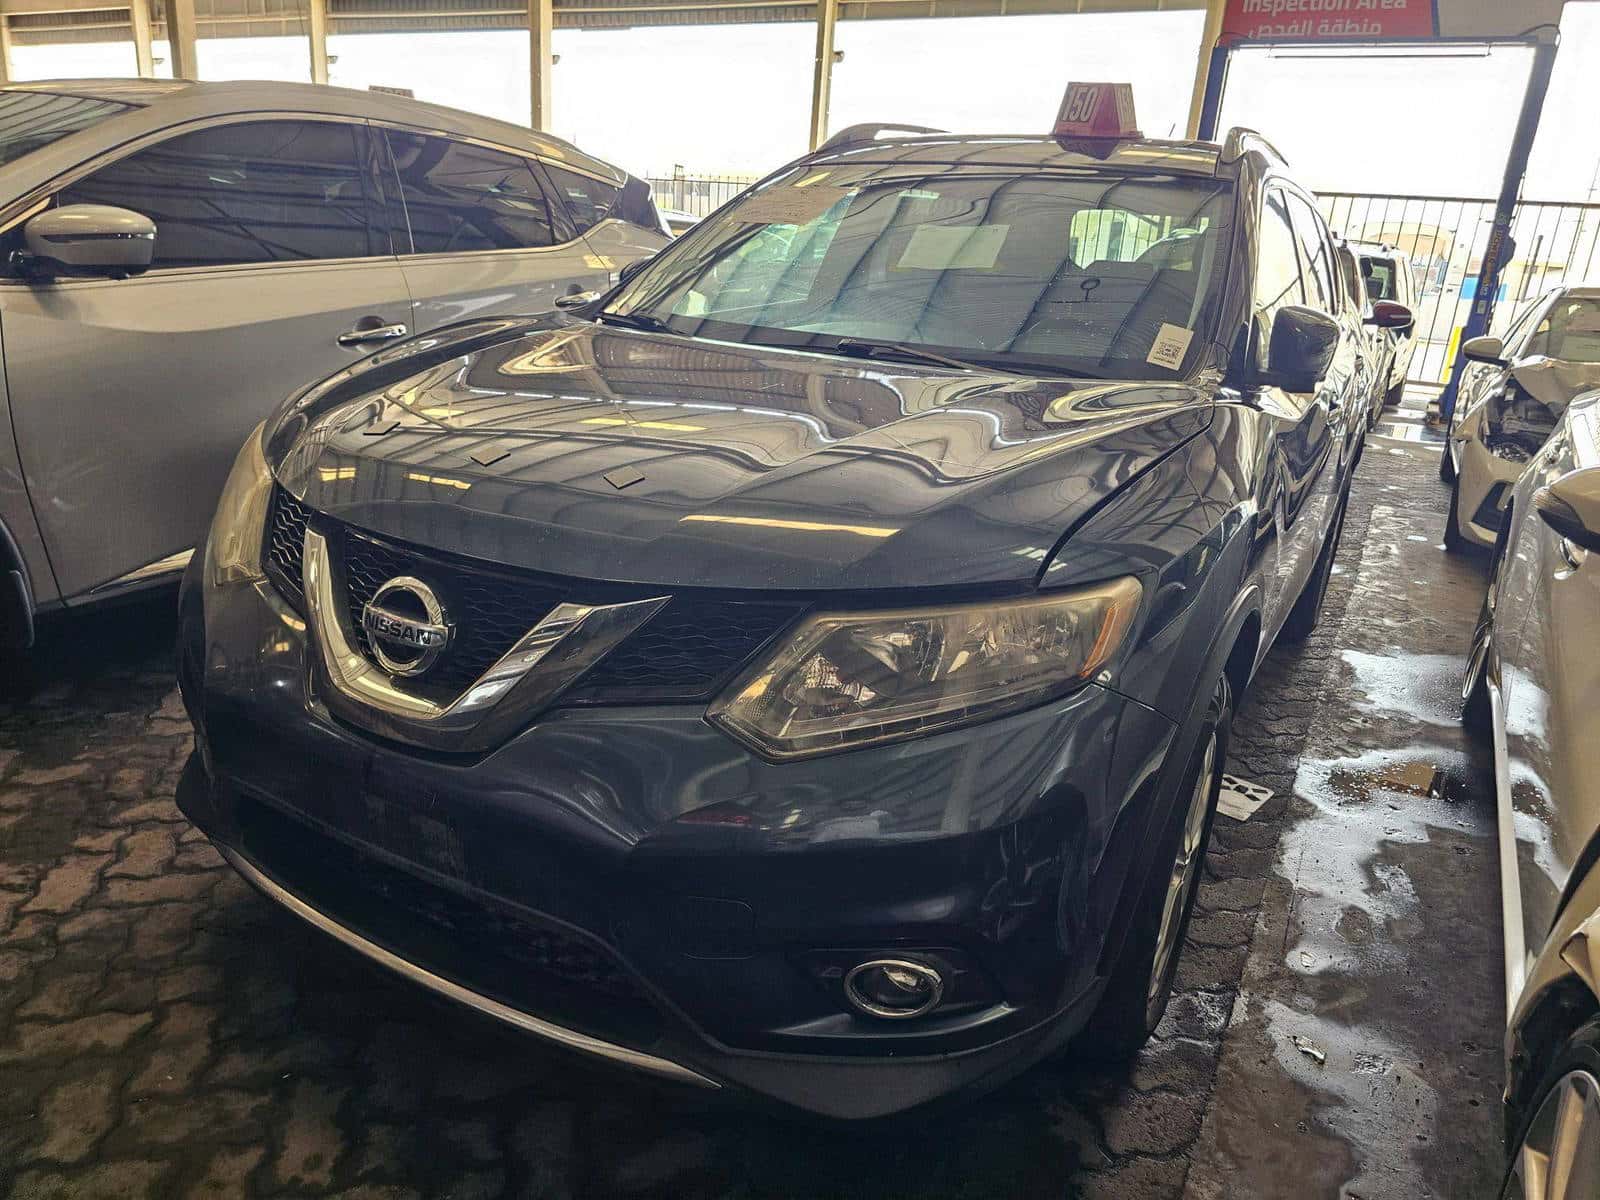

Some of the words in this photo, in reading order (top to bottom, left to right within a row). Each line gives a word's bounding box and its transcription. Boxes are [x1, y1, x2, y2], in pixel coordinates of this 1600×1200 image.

[1317, 18, 1382, 36] منطقة
[1062, 85, 1099, 122] 150
[366, 611, 432, 646] NISSAN
